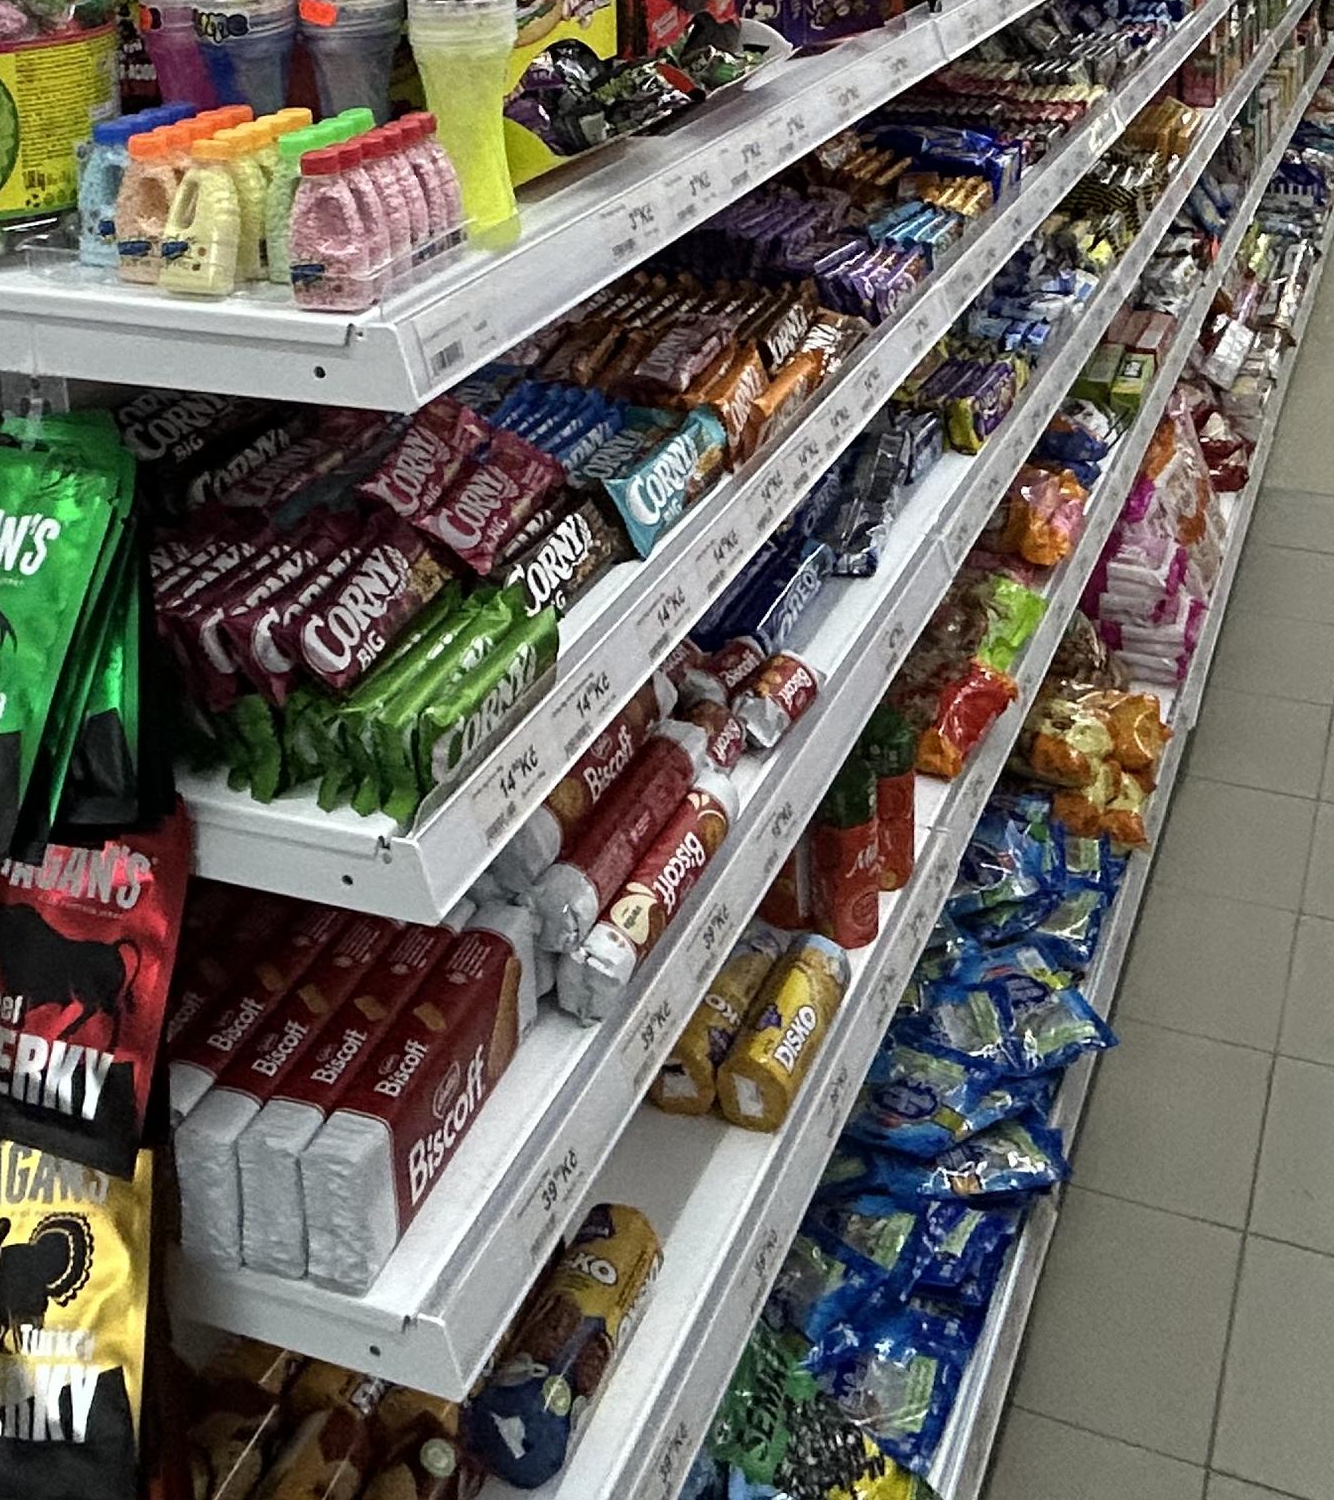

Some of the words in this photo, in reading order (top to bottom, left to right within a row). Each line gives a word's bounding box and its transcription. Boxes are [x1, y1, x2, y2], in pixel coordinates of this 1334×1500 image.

[628, 430, 701, 526] CORNY
[300, 546, 402, 675] CORNY
[355, 631, 387, 672] BIG
[584, 723, 634, 802] Biscoff
[651, 830, 706, 915] Biscoff
[207, 995, 265, 1052] Biscoff
[251, 1018, 310, 1078] Biscoff
[310, 1026, 368, 1086] Biscoff
[774, 1005, 819, 1076] DISKO
[374, 1037, 429, 1099] Biscoff
[407, 1044, 489, 1206] Biscoff
